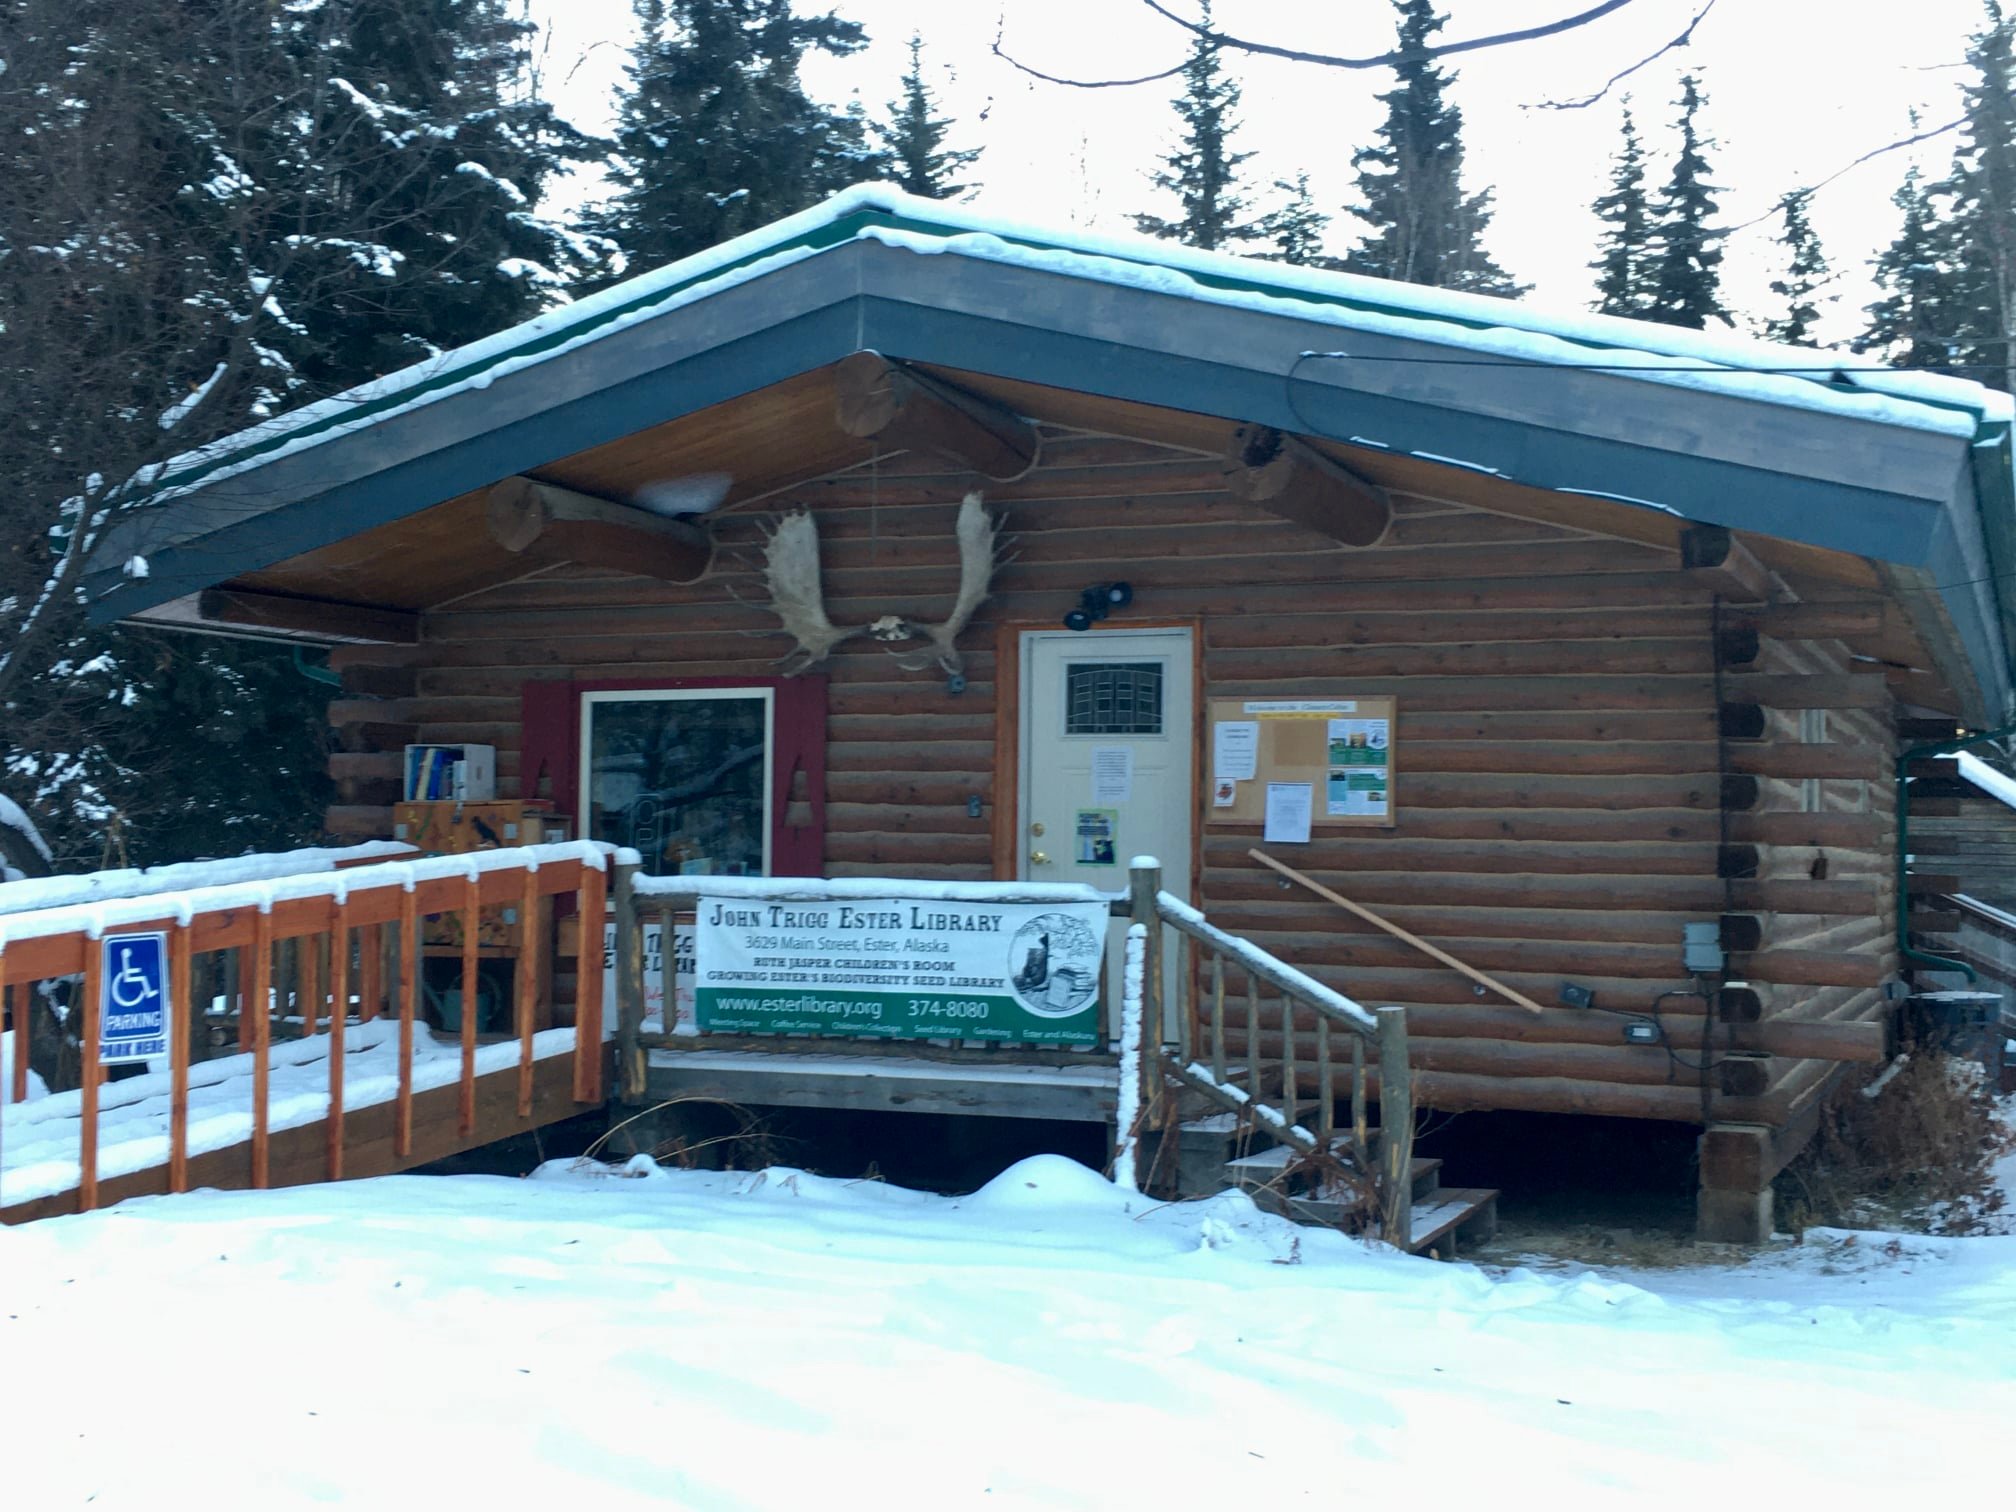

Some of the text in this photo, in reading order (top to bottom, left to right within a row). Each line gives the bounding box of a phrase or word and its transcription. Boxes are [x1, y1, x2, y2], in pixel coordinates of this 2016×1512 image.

[710, 904, 1003, 932] JOHN TRIGG ESTER LIBRARY
[745, 935, 950, 953] 3629 Main Street, Ester, Alaska
[754, 957, 956, 972] RUTH JASPER CHILDREN'S ROOM
[707, 970, 1005, 988] GROWING ESTER'S BIODIVERSITY SEED LIBRARY
[716, 995, 883, 1020] www.esterlibrary.org
[908, 999, 989, 1018] 374-8080
[105, 1011, 161, 1031] PARKING
